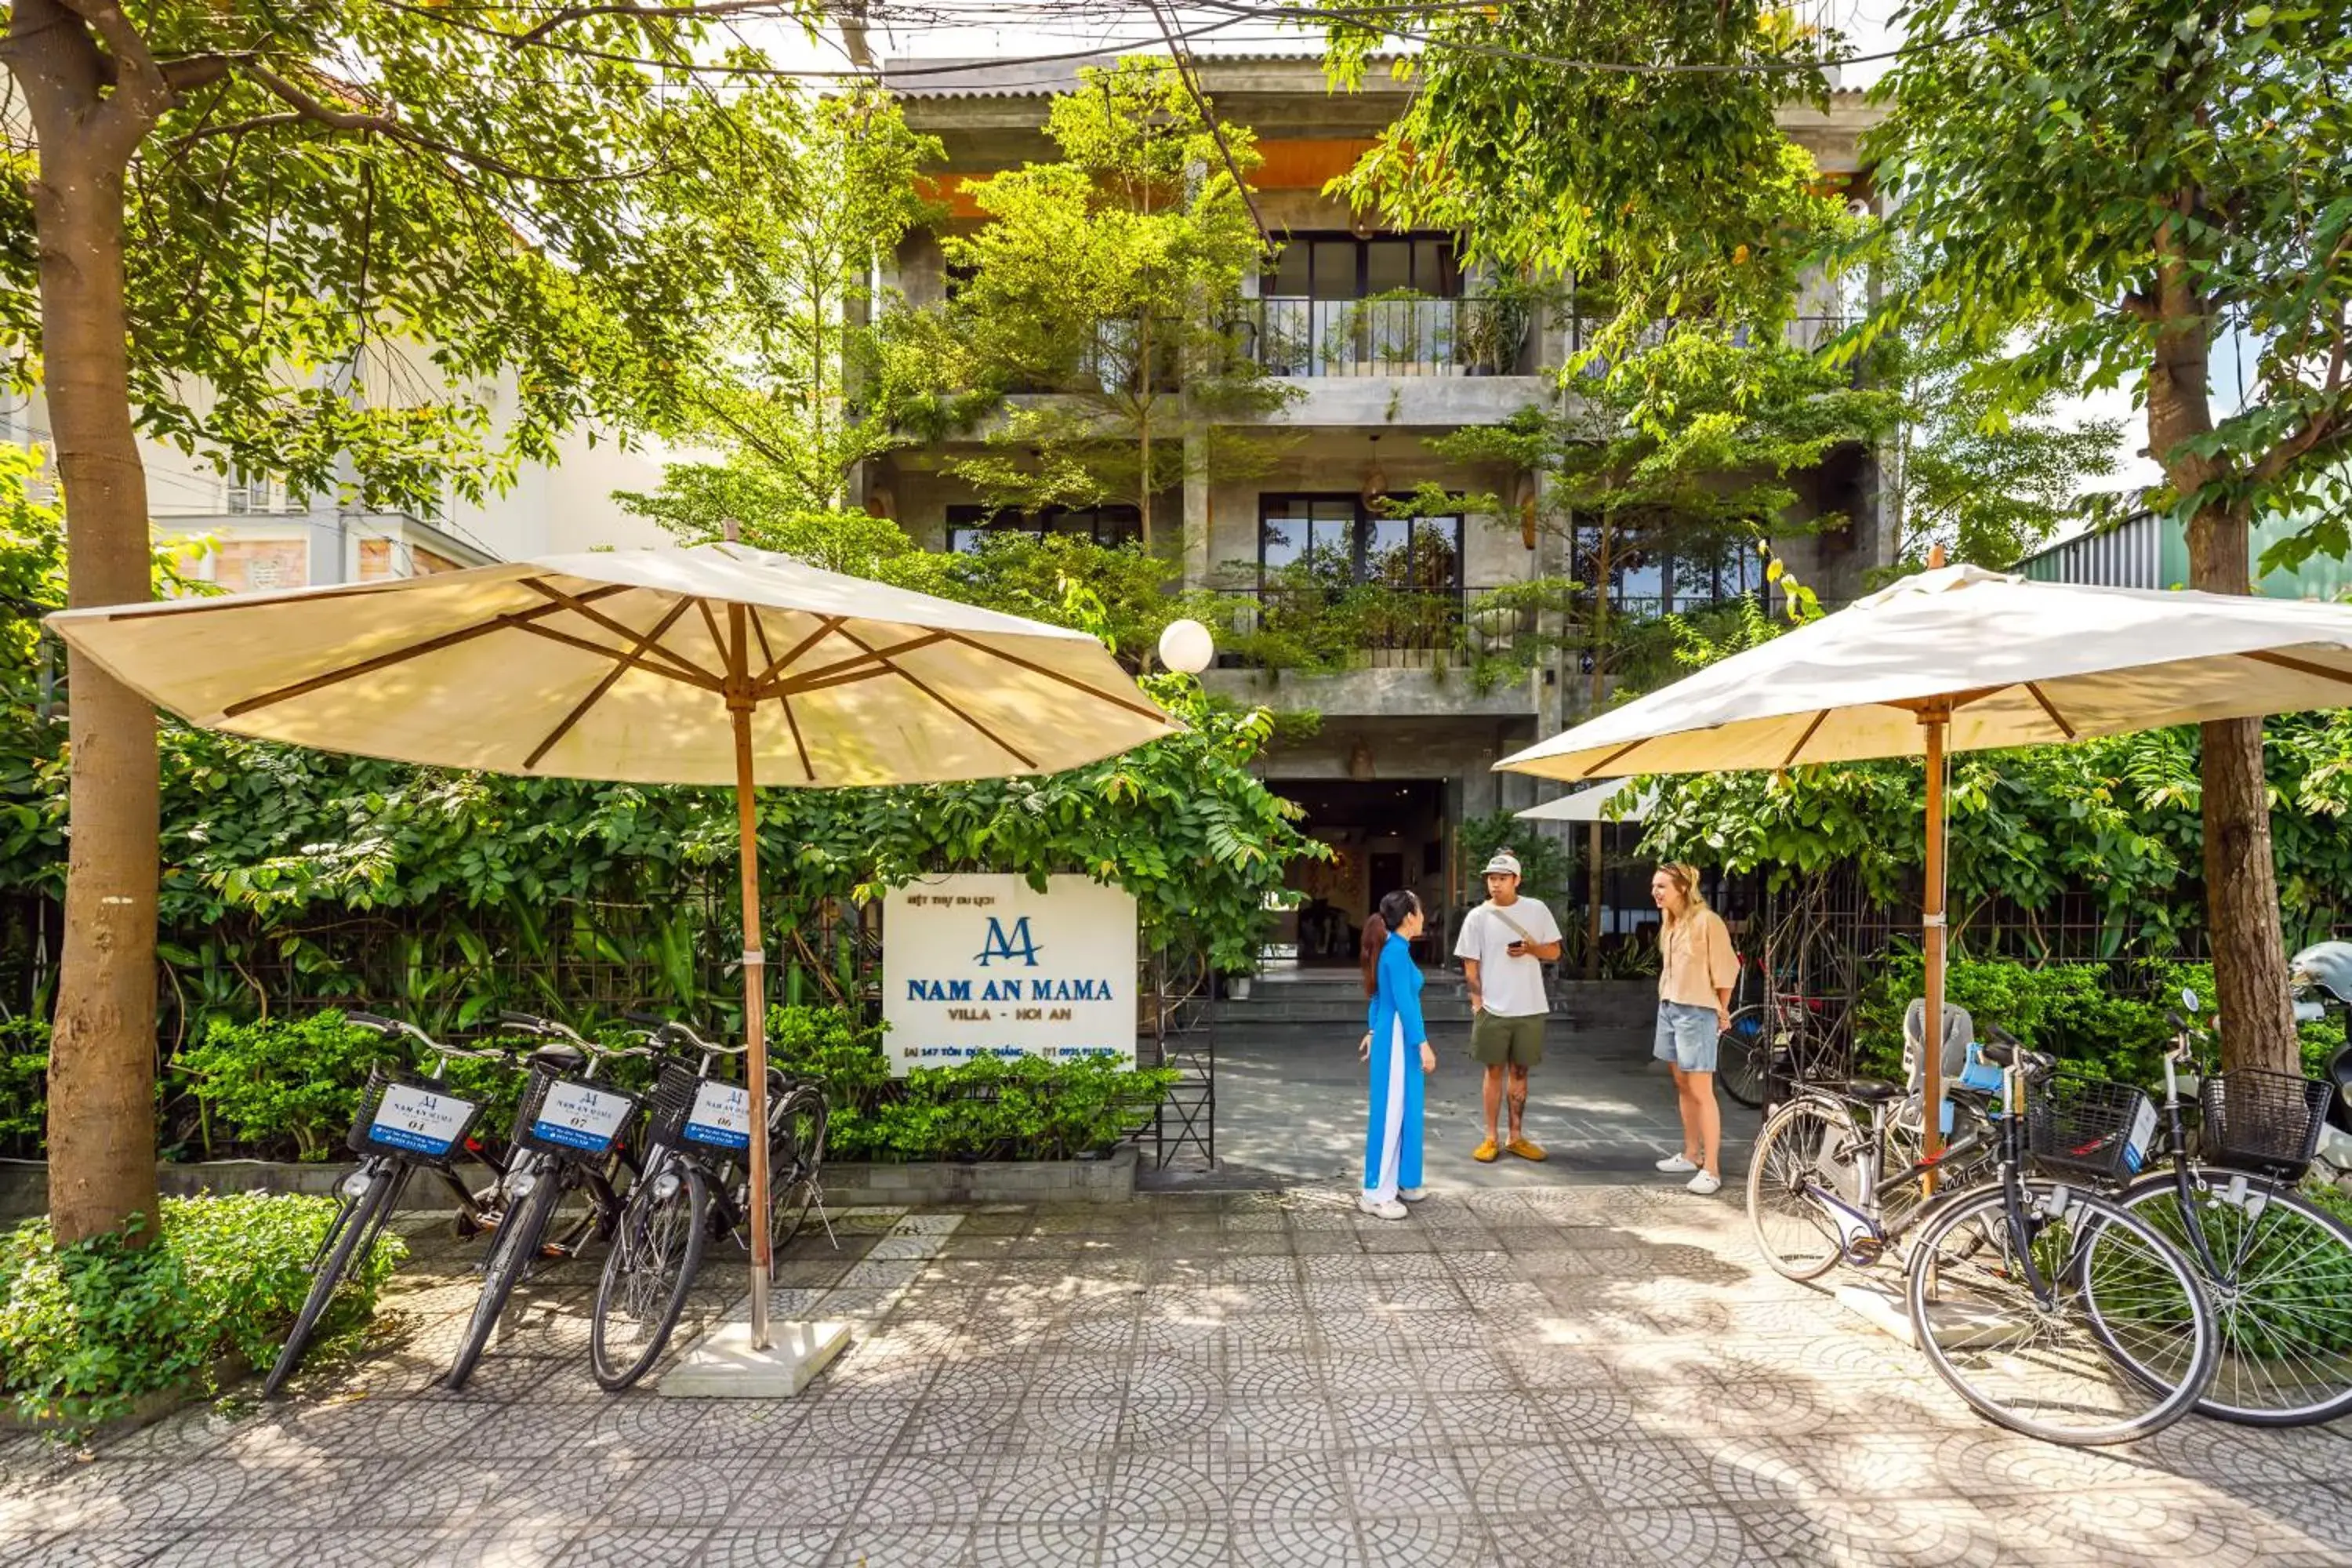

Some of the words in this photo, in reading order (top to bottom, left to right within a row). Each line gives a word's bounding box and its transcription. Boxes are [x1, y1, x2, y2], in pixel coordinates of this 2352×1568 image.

[907, 979, 972, 1001] NAM
[981, 979, 1023, 1001] AN
[1032, 978, 1114, 1001] MAMA
[948, 1008, 991, 1021] VILLA
[1016, 1008, 1042, 1021] HOI
[1049, 1008, 1072, 1021] AN
[921, 1047, 938, 1056] 147
[571, 1117, 587, 1127] 07
